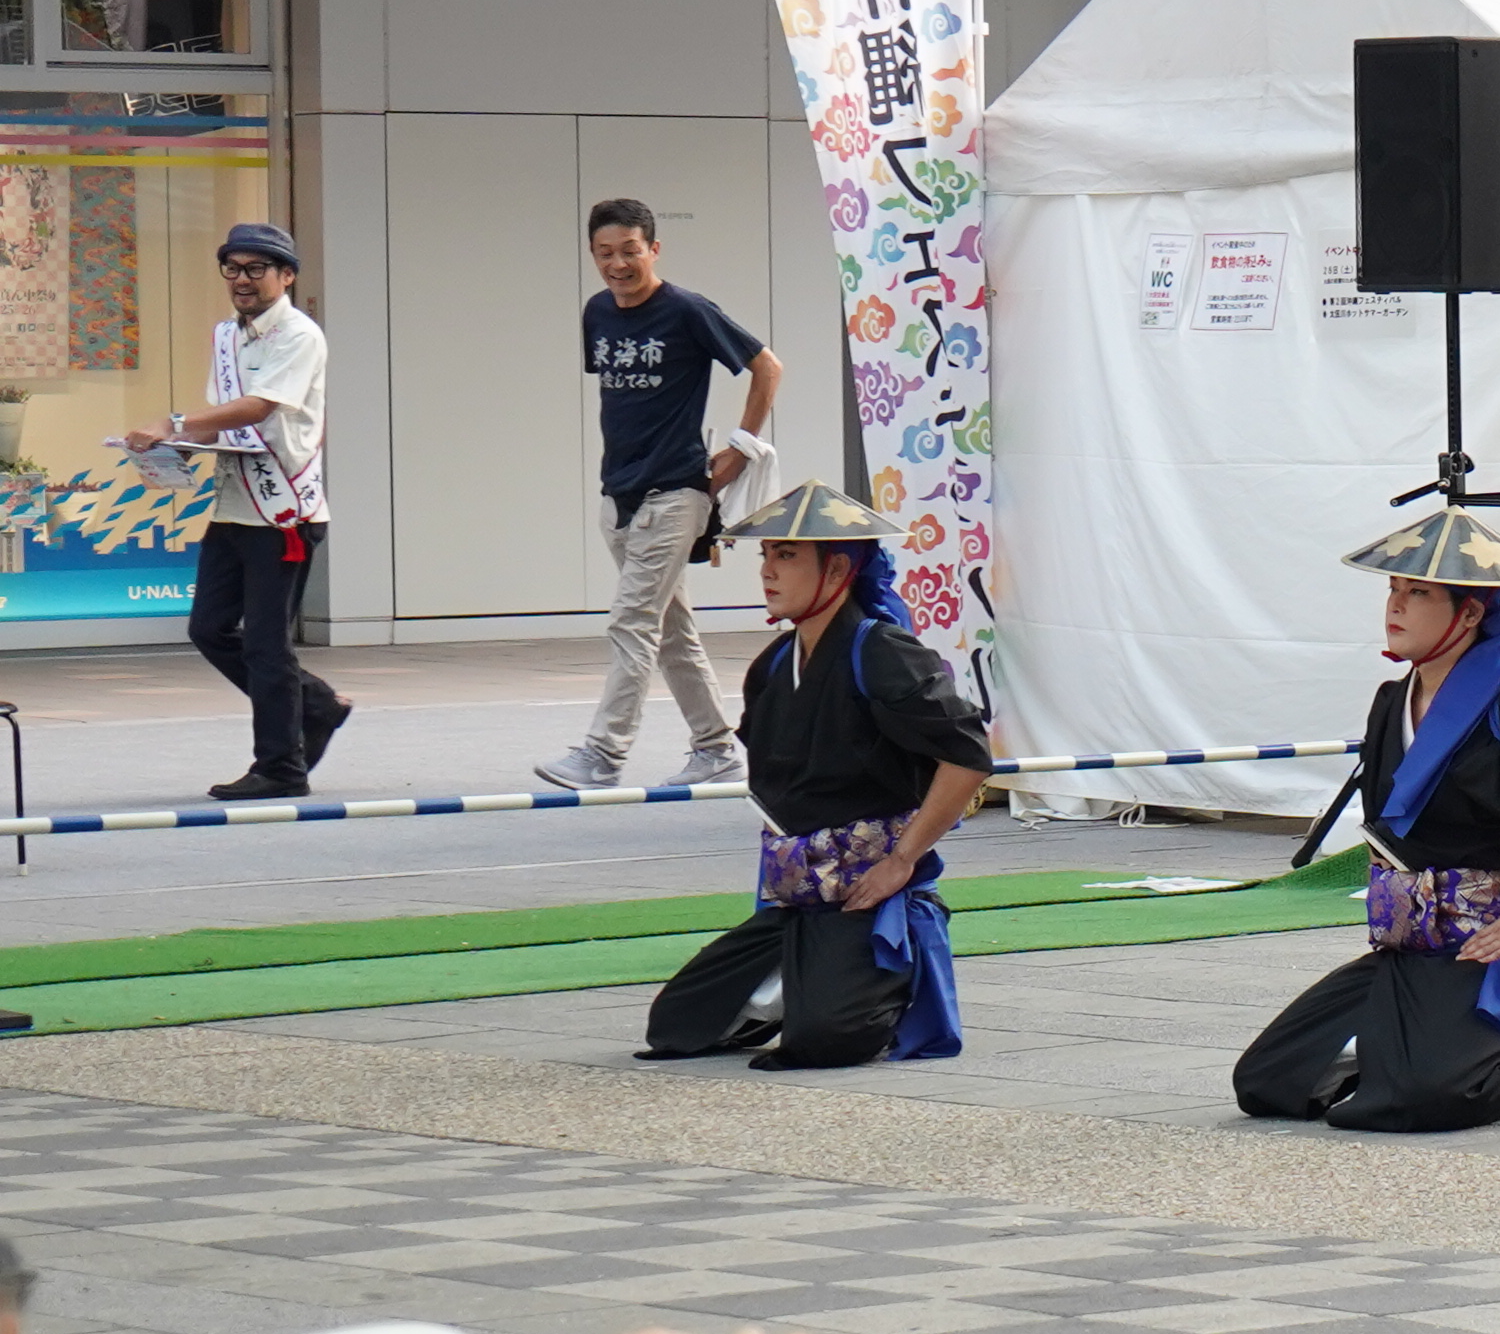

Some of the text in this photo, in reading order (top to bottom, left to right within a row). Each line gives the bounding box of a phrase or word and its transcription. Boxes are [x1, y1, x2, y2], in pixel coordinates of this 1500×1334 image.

[1151, 270, 1174, 288] WC
[593, 336, 666, 368] 東海市
